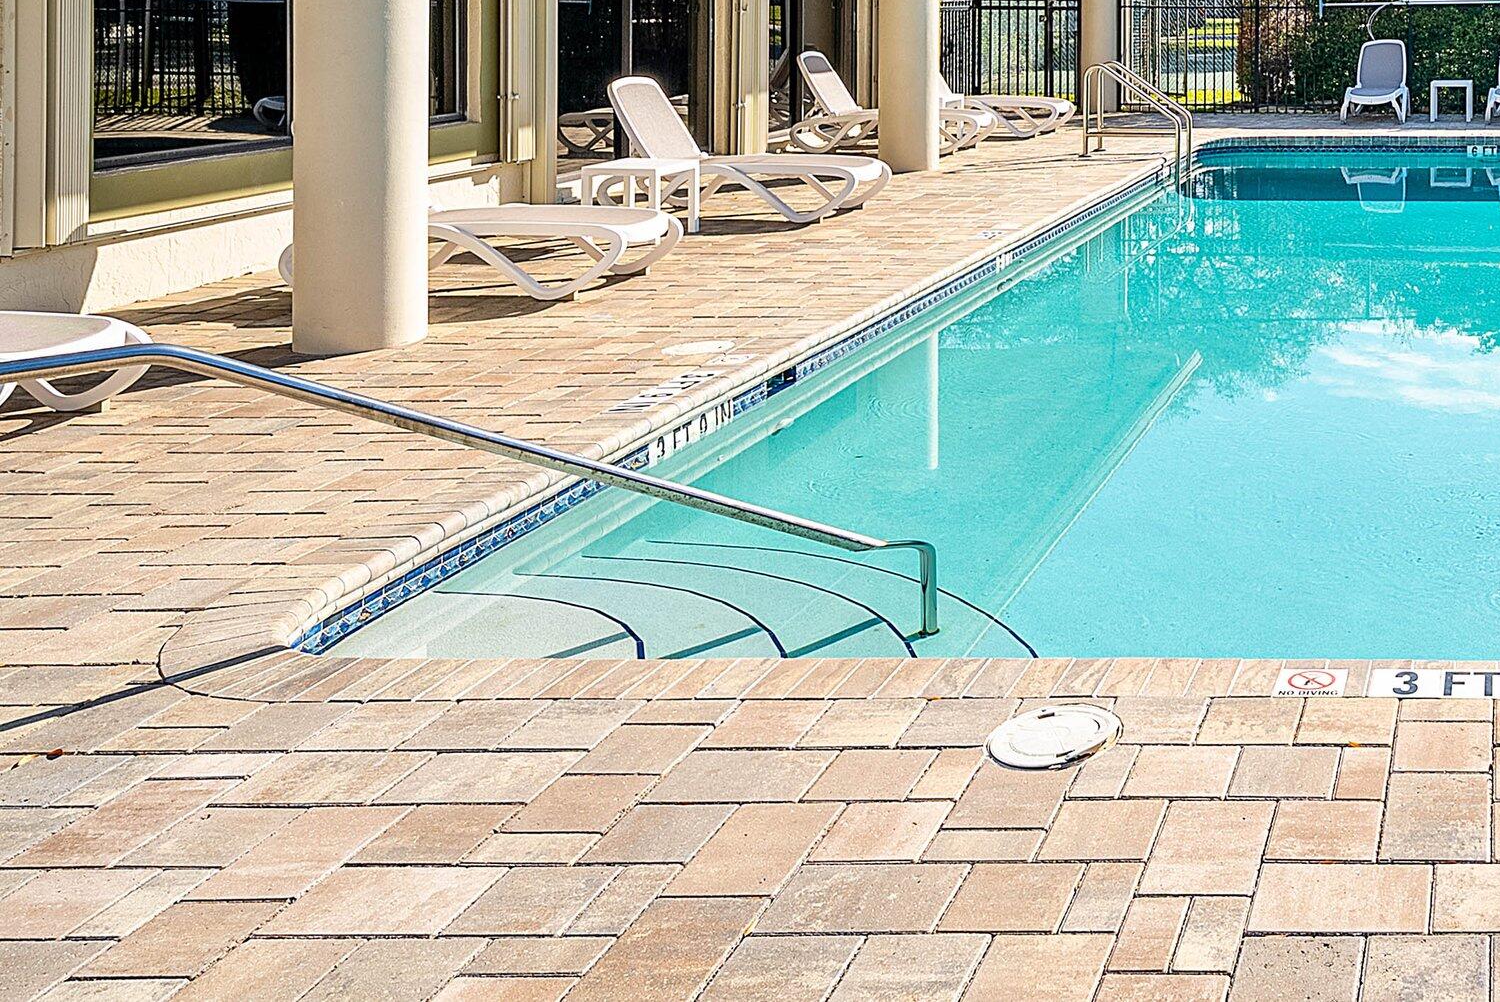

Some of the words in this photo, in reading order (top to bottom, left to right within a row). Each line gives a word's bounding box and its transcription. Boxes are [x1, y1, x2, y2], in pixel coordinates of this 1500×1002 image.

[656, 436, 665, 458] 3
[672, 419, 693, 450] FT
[714, 399, 731, 426] IN
[1392, 671, 1419, 695] 3
